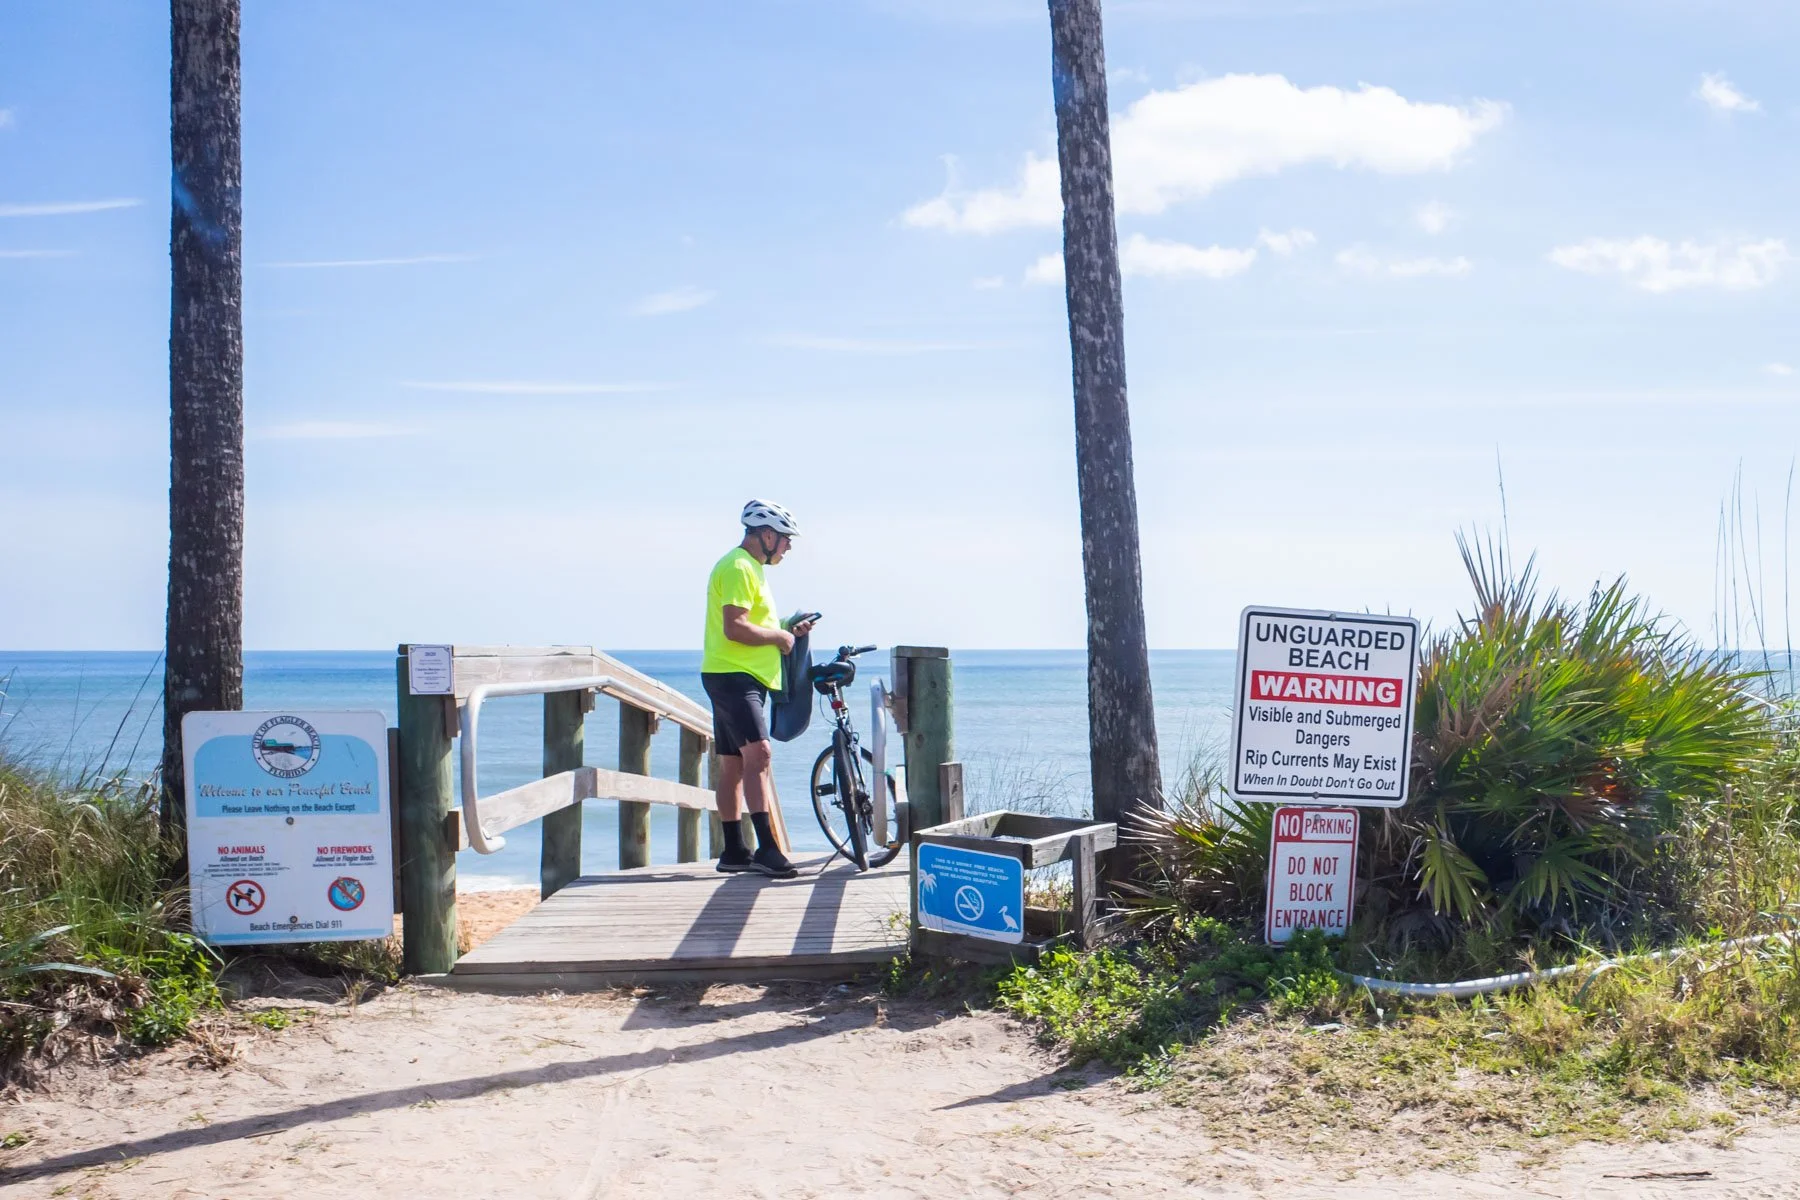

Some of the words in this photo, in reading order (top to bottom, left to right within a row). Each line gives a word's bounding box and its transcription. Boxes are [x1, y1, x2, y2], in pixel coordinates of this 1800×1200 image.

[1256, 623, 1405, 650] UNGUARDED
[1289, 648, 1369, 670] BEACH
[1258, 675, 1396, 703] WARNING
[1249, 706, 1293, 723] Visible
[1297, 710, 1321, 725] and
[1326, 710, 1401, 731] Submerged
[254, 731, 262, 748] CITY
[304, 726, 320, 749] BEACH
[1296, 730, 1350, 749] Dangers
[1246, 749, 1268, 768] Rip
[1272, 750, 1328, 768] Currents
[1333, 754, 1360, 772] May
[1364, 755, 1396, 771] Exist
[269, 767, 306, 778] FLORIDA
[200, 784, 246, 798] Welcome
[252, 786, 262, 796] to
[266, 788, 283, 796] our
[288, 783, 335, 799] Peaceful
[340, 781, 371, 795] Beach
[1243, 774, 1274, 786] When
[1277, 774, 1287, 786] In
[1290, 775, 1323, 787] Doubt
[1326, 777, 1354, 789] Don't
[1357, 778, 1372, 790] Go
[1376, 779, 1395, 790] Out
[222, 805, 242, 813] Please
[264, 804, 290, 814] Nothing
[314, 803, 333, 811] Beach
[335, 803, 355, 812] Except
[1279, 814, 1300, 836] NO
[1305, 818, 1352, 834] PARKING
[317, 846, 328, 854] NO
[330, 845, 373, 854] FIREWORKS
[1288, 857, 1305, 875] DO
[1313, 857, 1339, 875] NOT
[1290, 883, 1333, 901] BLOCK
[250, 922, 270, 931] Beach
[272, 922, 314, 932] Emergencies
[315, 920, 330, 929] Dial
[332, 920, 342, 928] 911
[1275, 910, 1344, 928] ENTRANCE
